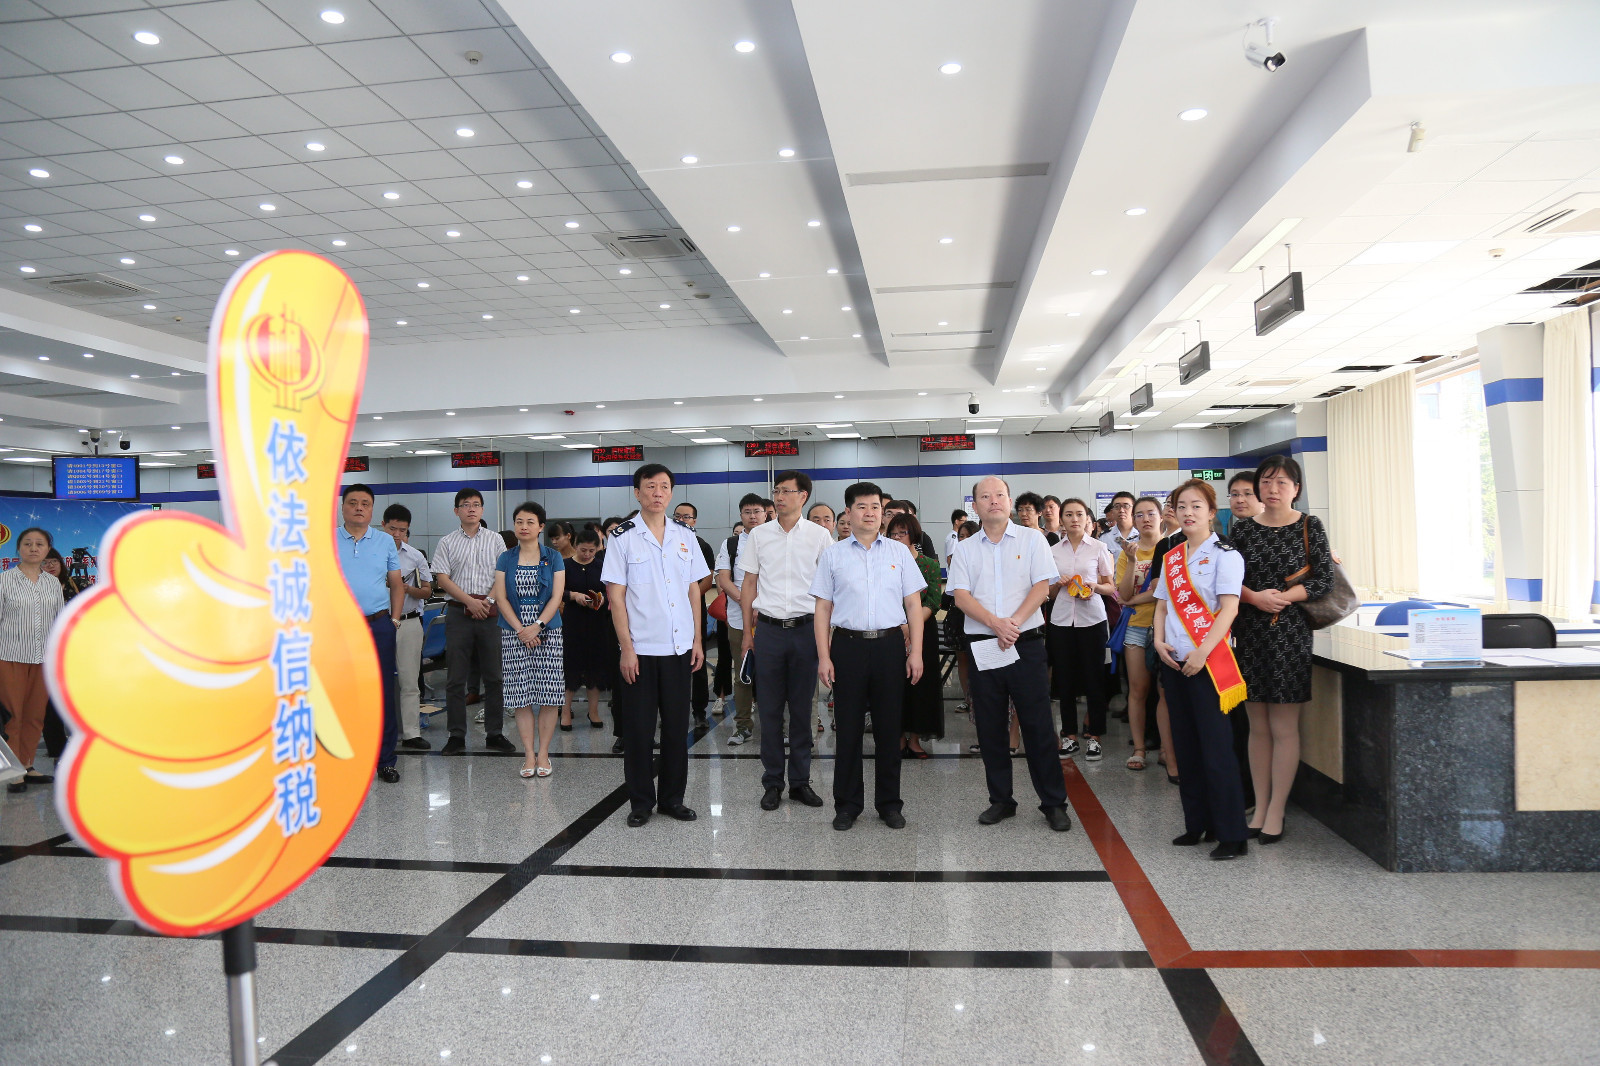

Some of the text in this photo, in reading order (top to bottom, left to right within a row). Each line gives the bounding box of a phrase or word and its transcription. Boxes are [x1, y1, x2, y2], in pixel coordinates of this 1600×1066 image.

[266, 419, 321, 836] 依法诚信纳税
